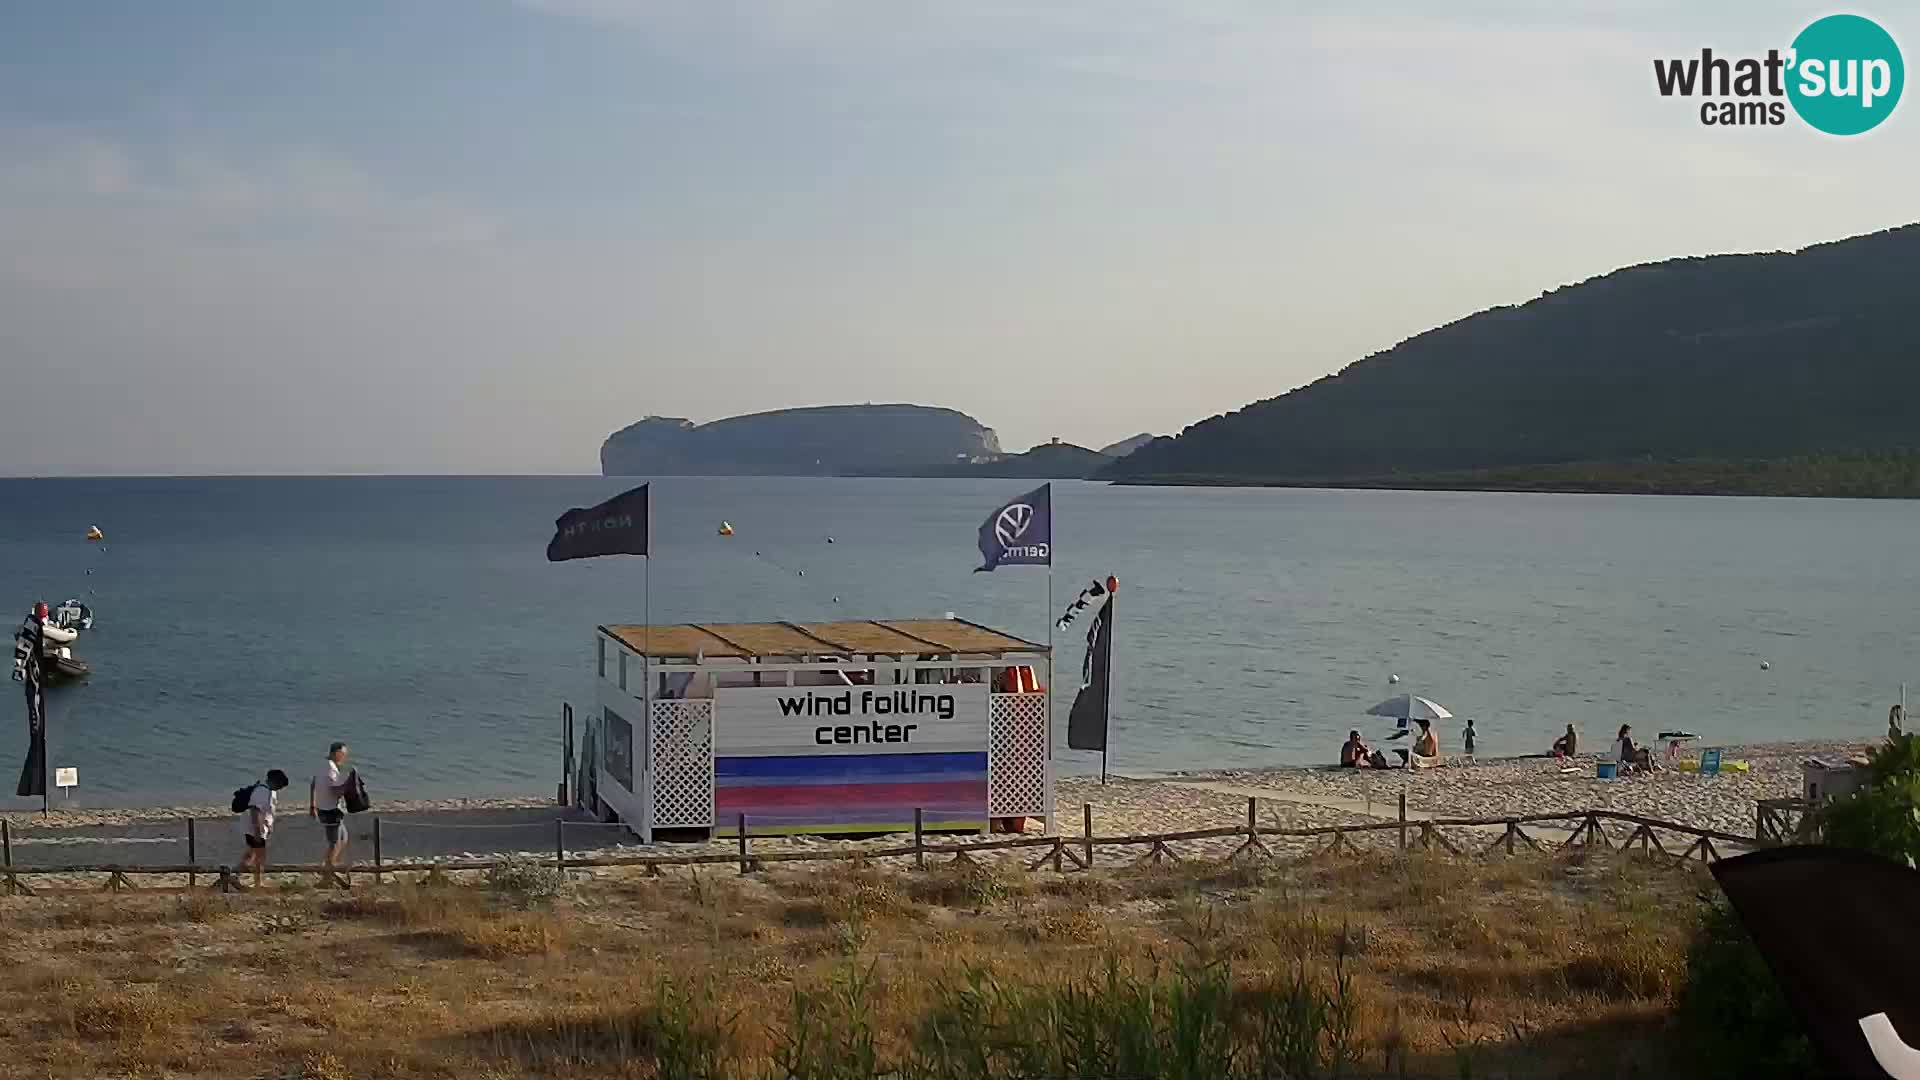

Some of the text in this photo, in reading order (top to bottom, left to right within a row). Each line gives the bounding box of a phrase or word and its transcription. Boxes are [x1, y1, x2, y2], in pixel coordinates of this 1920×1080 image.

[777, 690, 955, 720] wind foiling
[815, 720, 918, 745] center
